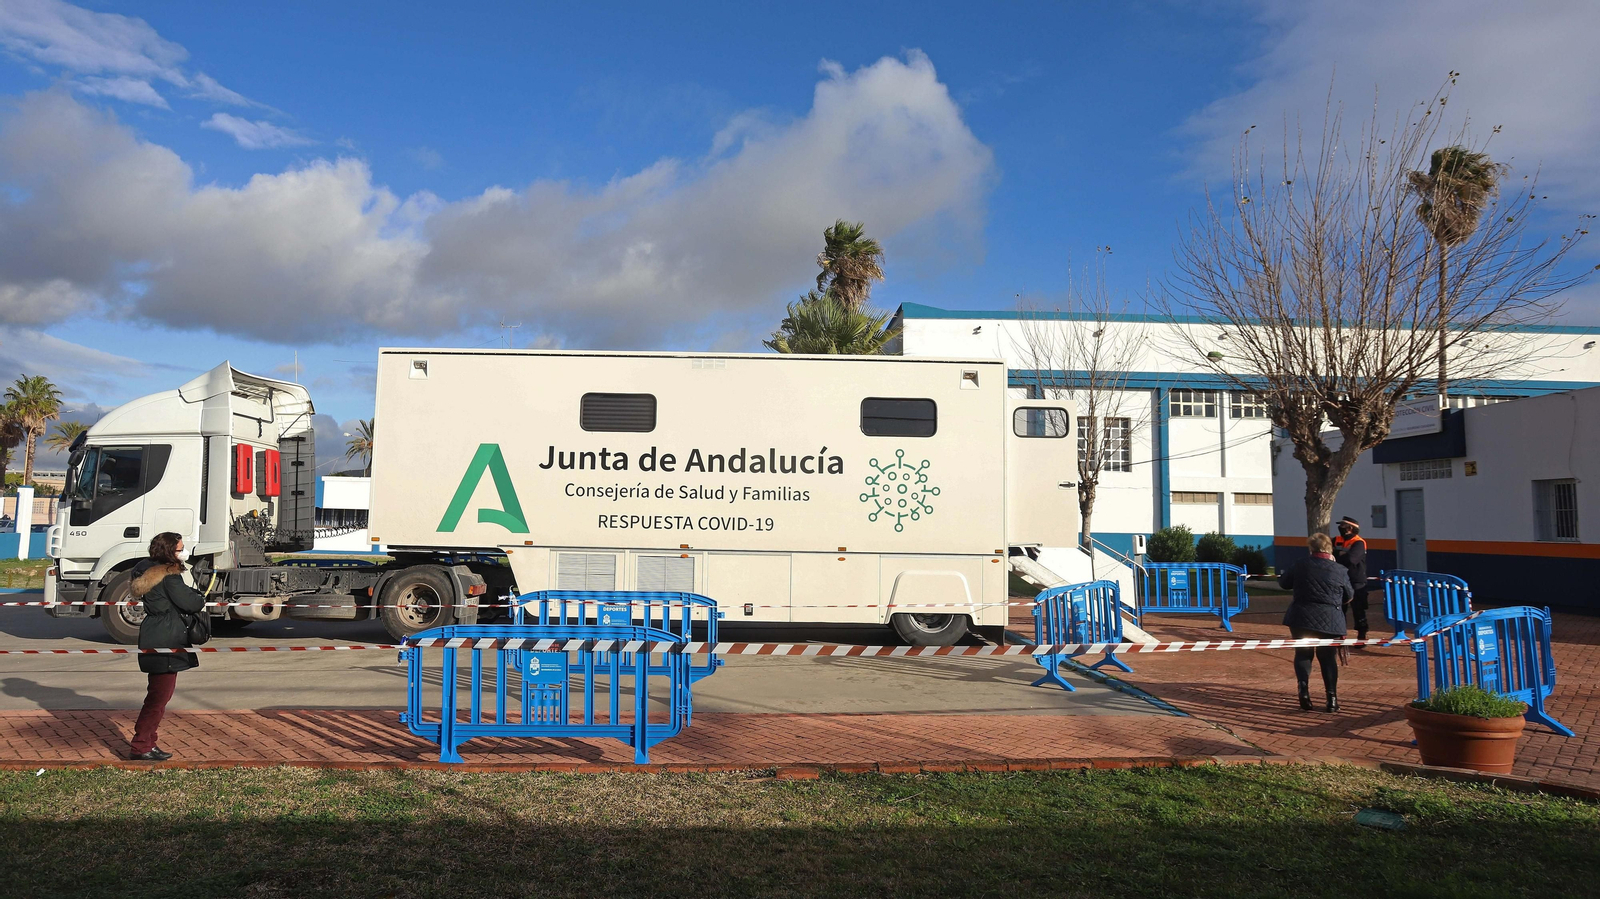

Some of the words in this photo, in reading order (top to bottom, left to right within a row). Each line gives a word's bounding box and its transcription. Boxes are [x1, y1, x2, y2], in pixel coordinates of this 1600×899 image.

[538, 445, 628, 471] Junta
[638, 446, 677, 472] de
[684, 445, 844, 475] Andalucía
[564, 482, 650, 502] Consejería
[654, 483, 674, 499] de
[678, 484, 725, 500] Salud
[729, 489, 739, 504] y
[743, 486, 811, 502] Familias
[598, 514, 694, 530] RESPUESTA
[698, 516, 774, 532] COVID-19
